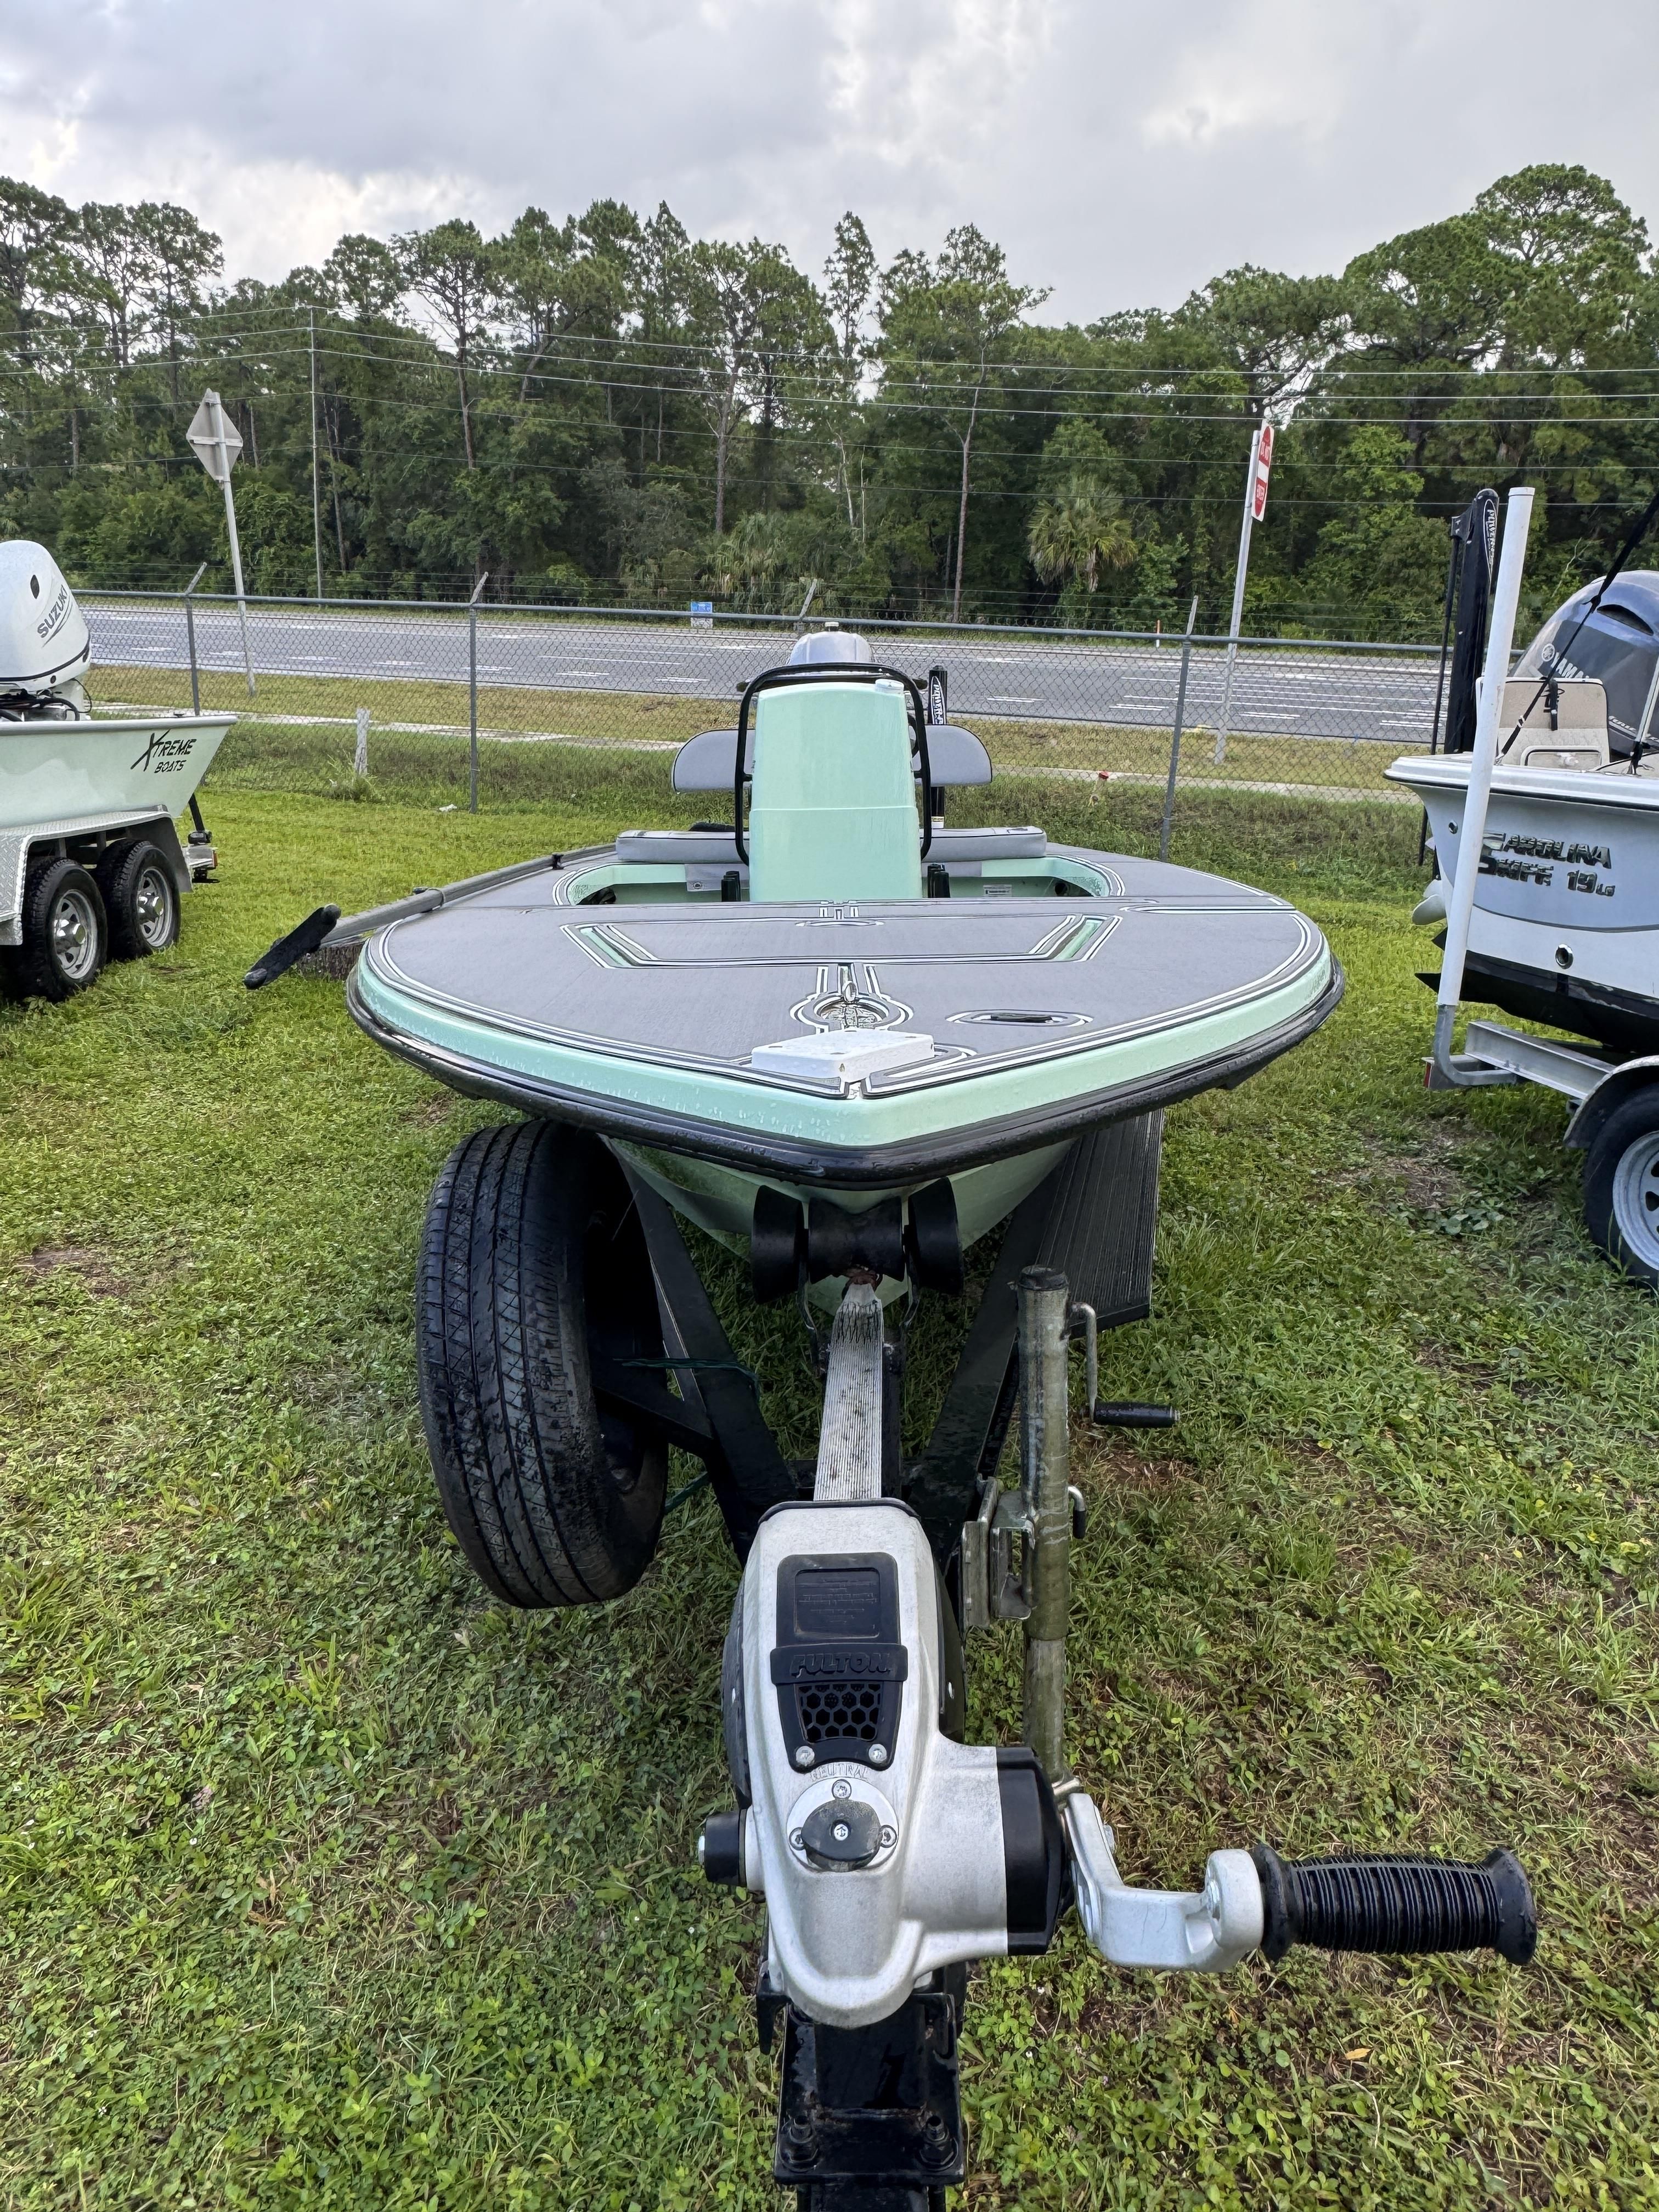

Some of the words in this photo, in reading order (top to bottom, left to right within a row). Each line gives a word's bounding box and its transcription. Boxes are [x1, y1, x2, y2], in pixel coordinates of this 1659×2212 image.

[37, 584, 68, 638] SUZUKI
[130, 729, 197, 772] XTREME
[154, 760, 187, 774] BOATS
[791, 1651, 889, 1678] FULTON
